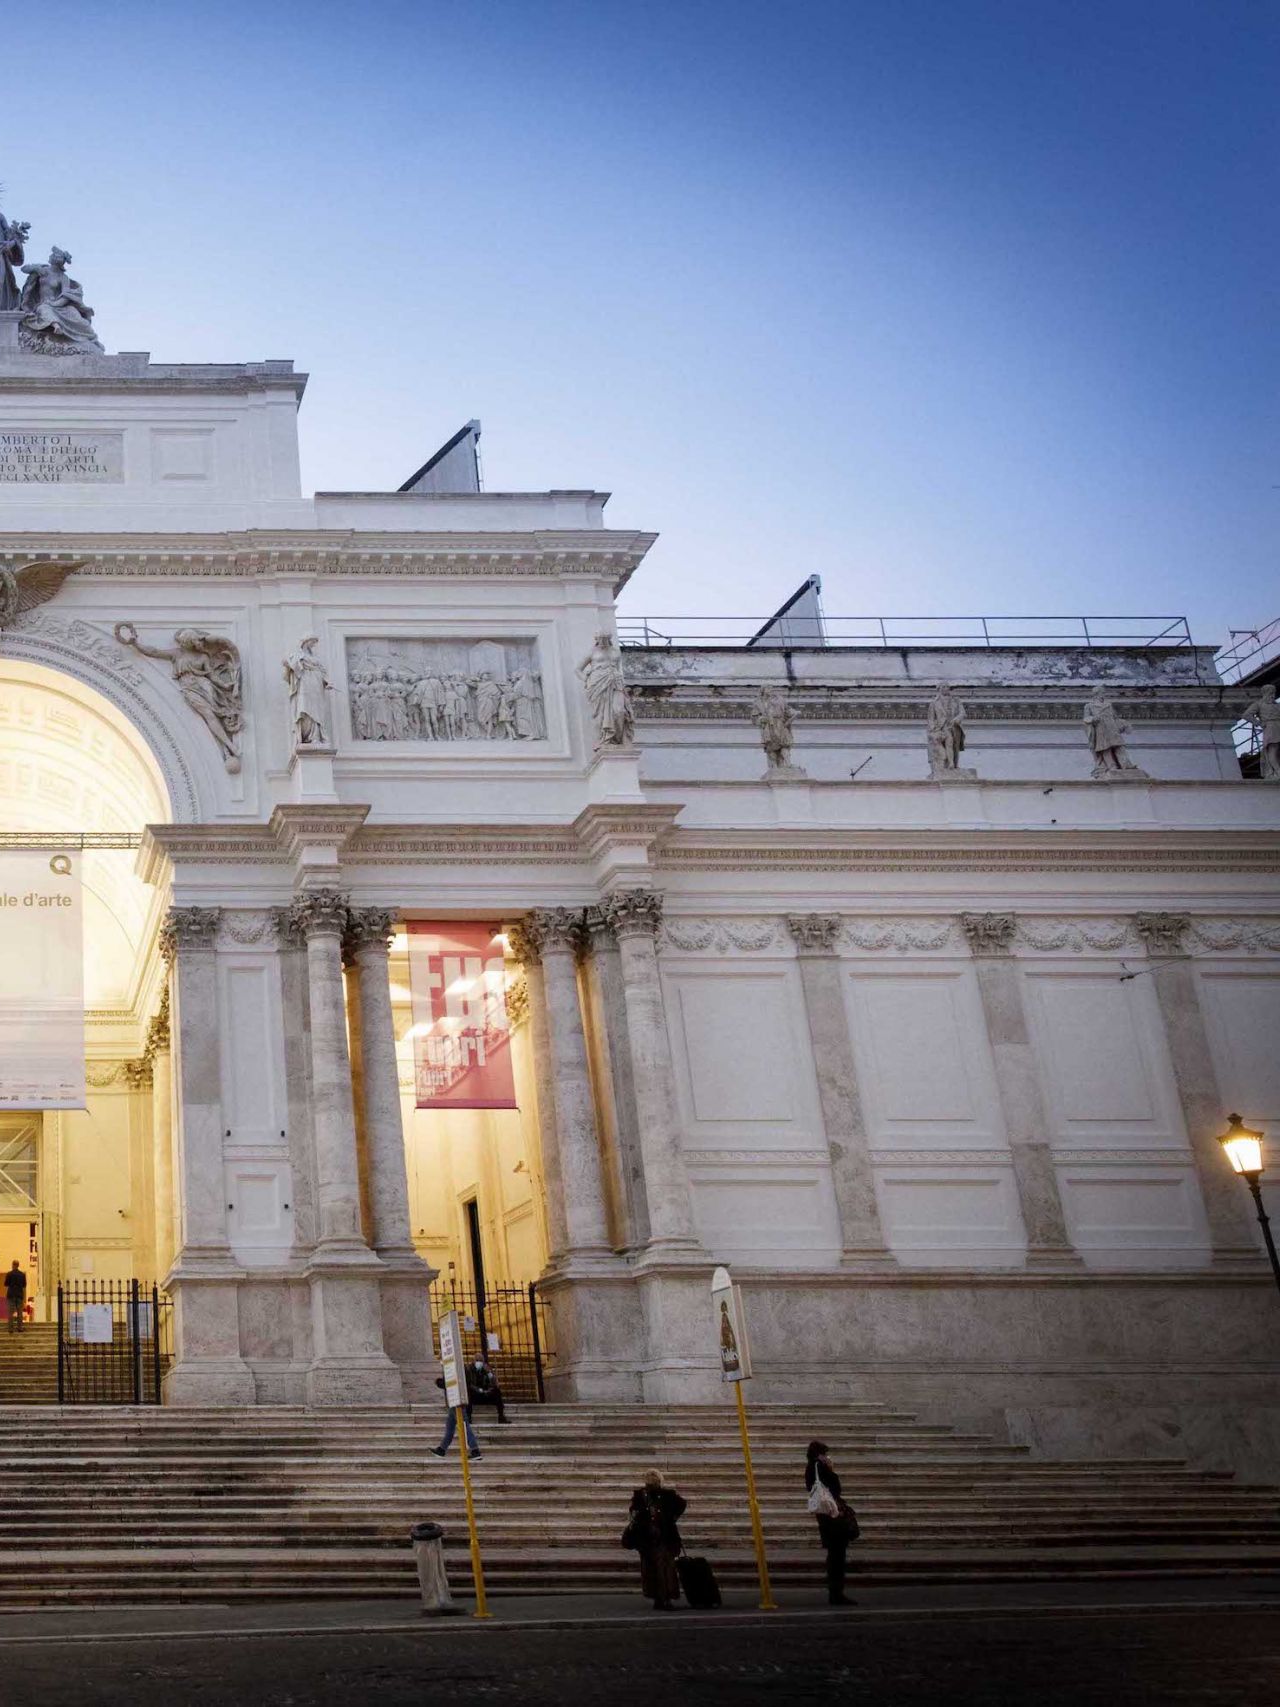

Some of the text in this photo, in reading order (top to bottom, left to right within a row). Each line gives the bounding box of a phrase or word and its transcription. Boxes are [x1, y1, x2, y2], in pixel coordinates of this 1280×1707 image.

[17, 455, 56, 463] BELLE
[65, 455, 95, 464] ARTI
[38, 464, 108, 473] PROVINCIA
[23, 893, 73, 907] d'arte
